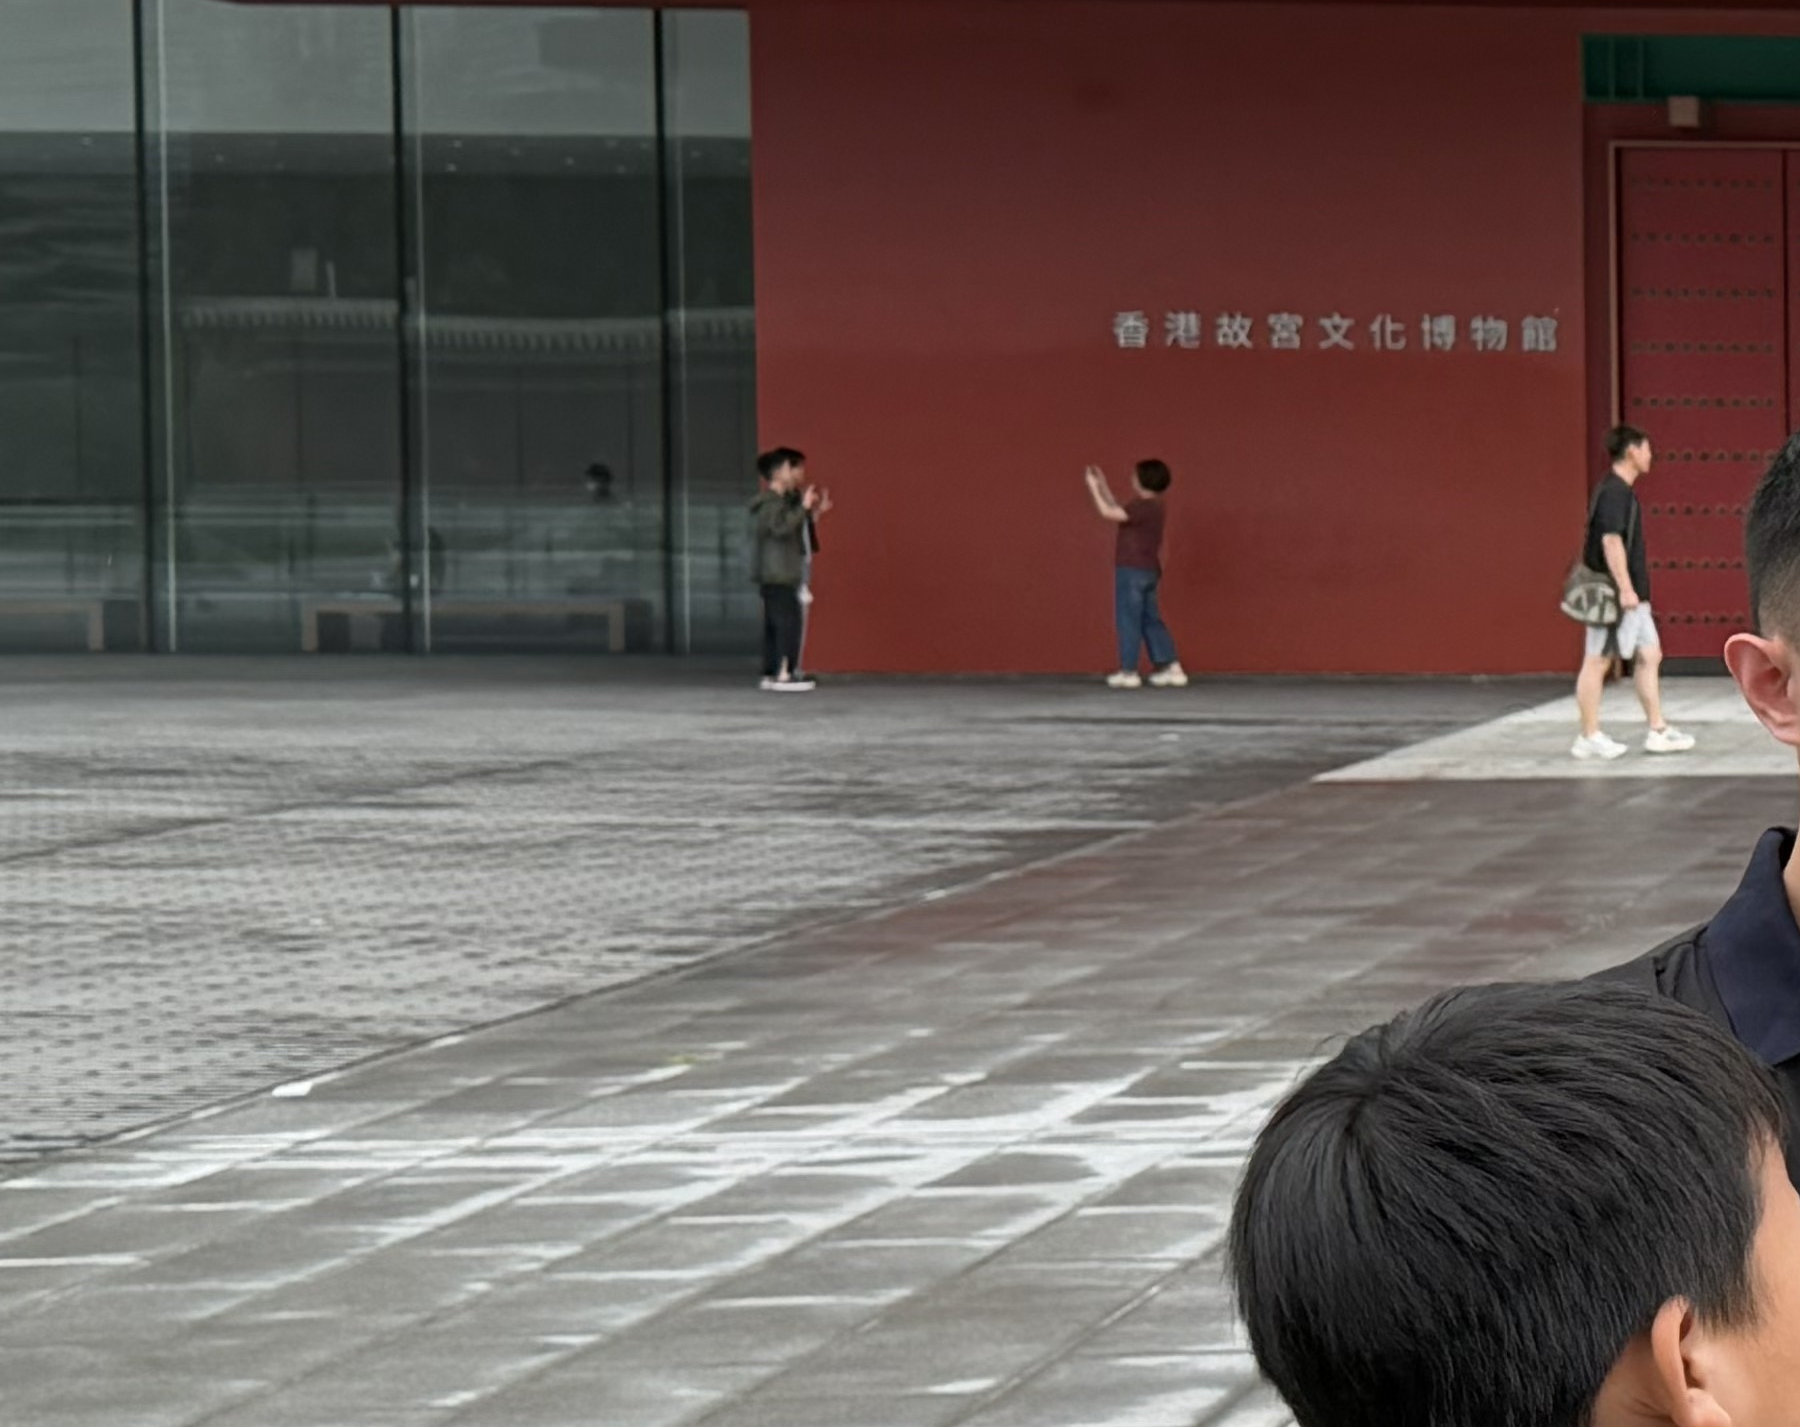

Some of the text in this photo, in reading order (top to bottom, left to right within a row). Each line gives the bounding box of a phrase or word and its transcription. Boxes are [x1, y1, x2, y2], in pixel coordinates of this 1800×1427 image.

[1113, 310, 1558, 353] 香港故宮文化博物館
